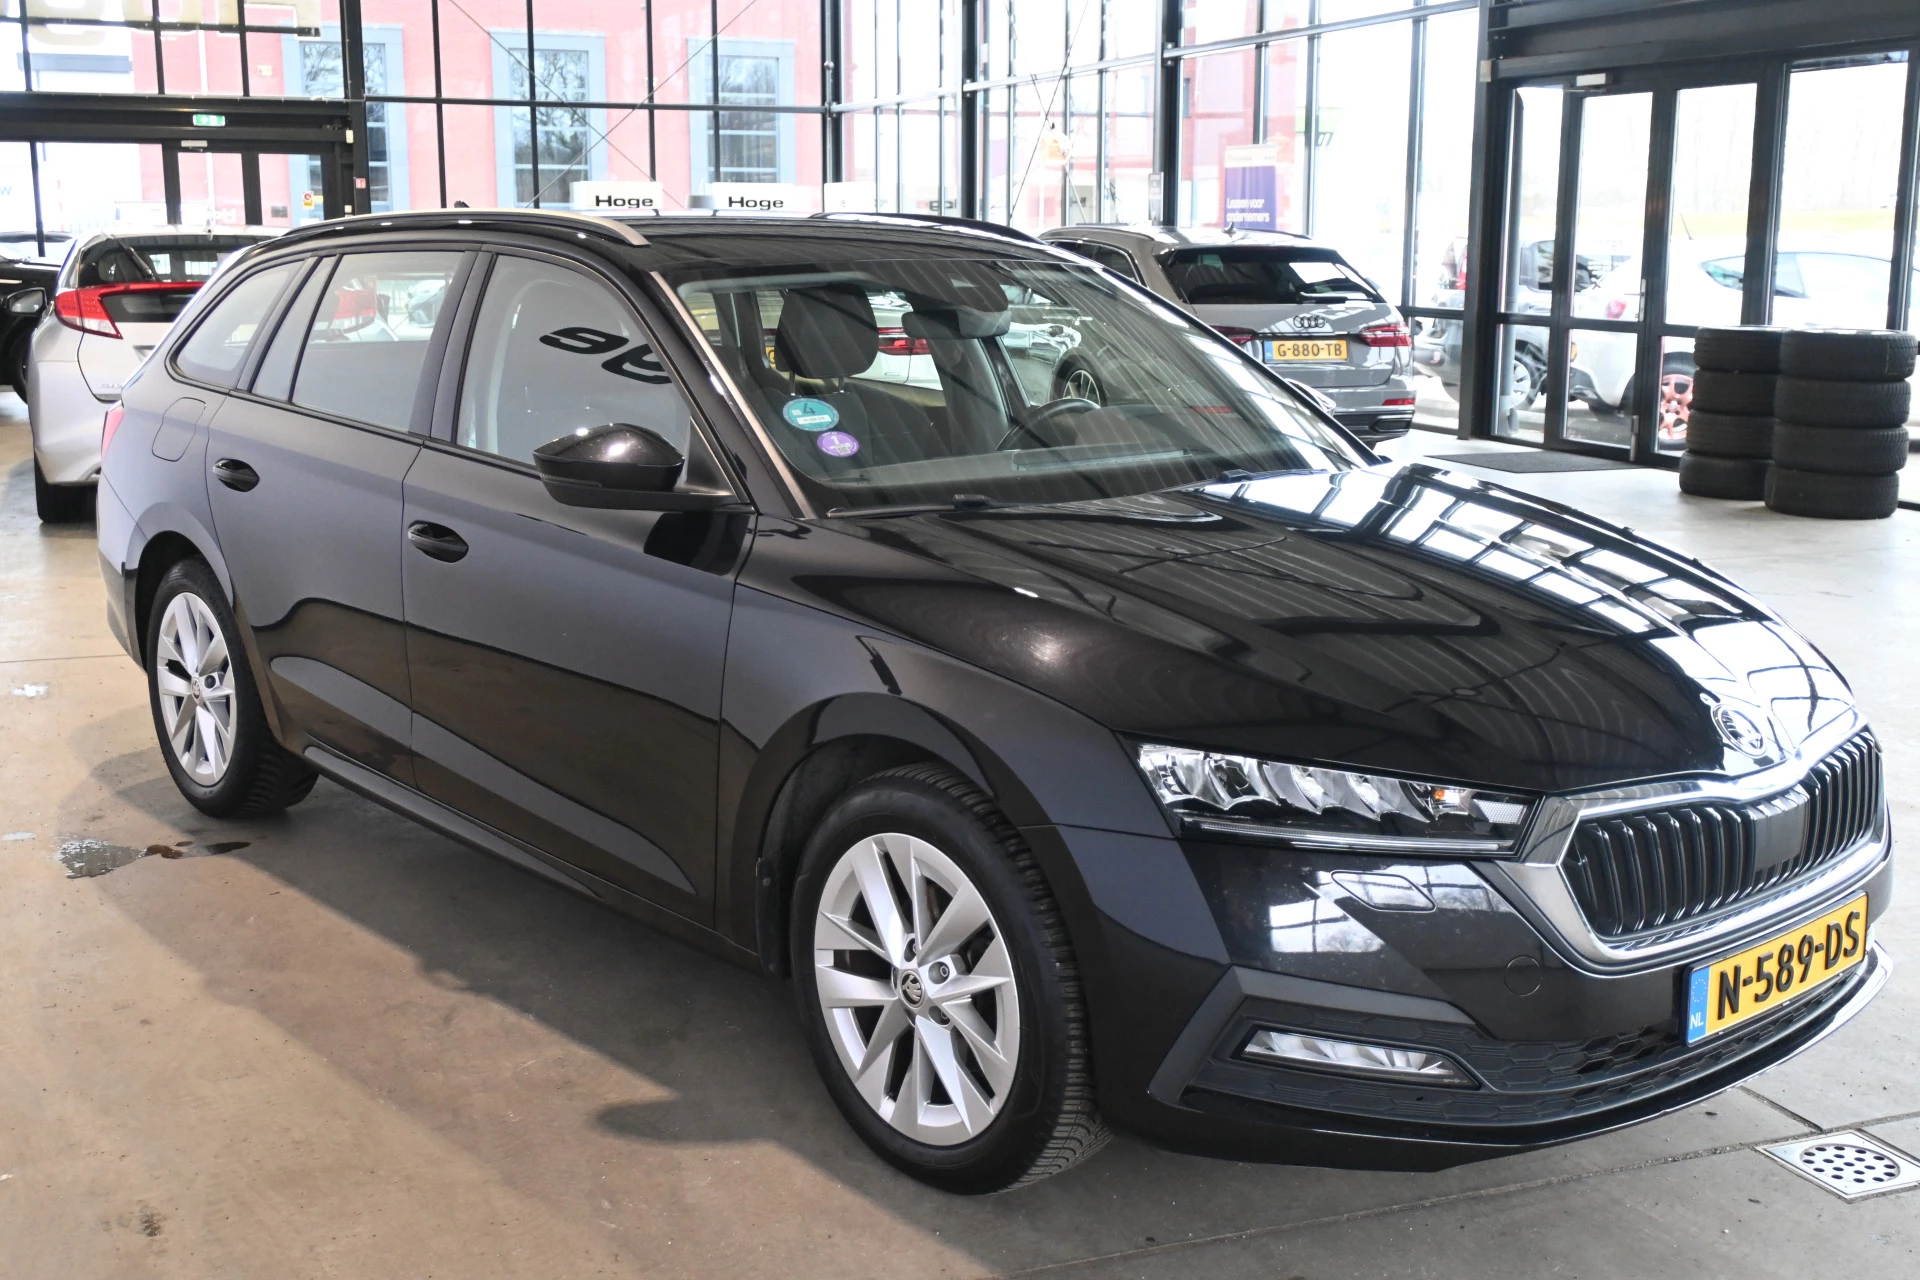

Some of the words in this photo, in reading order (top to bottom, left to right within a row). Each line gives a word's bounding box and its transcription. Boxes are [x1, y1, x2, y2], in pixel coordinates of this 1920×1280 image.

[595, 195, 654, 210] Hoge
[729, 196, 784, 211] Hoge
[1250, 199, 1265, 209] voor
[1227, 211, 1270, 222] ondernemers
[1278, 343, 1342, 357] G-880-TB
[802, 403, 816, 415] 4
[1718, 910, 1861, 1020] N-589-DS
[1690, 1012, 1704, 1030] NL
